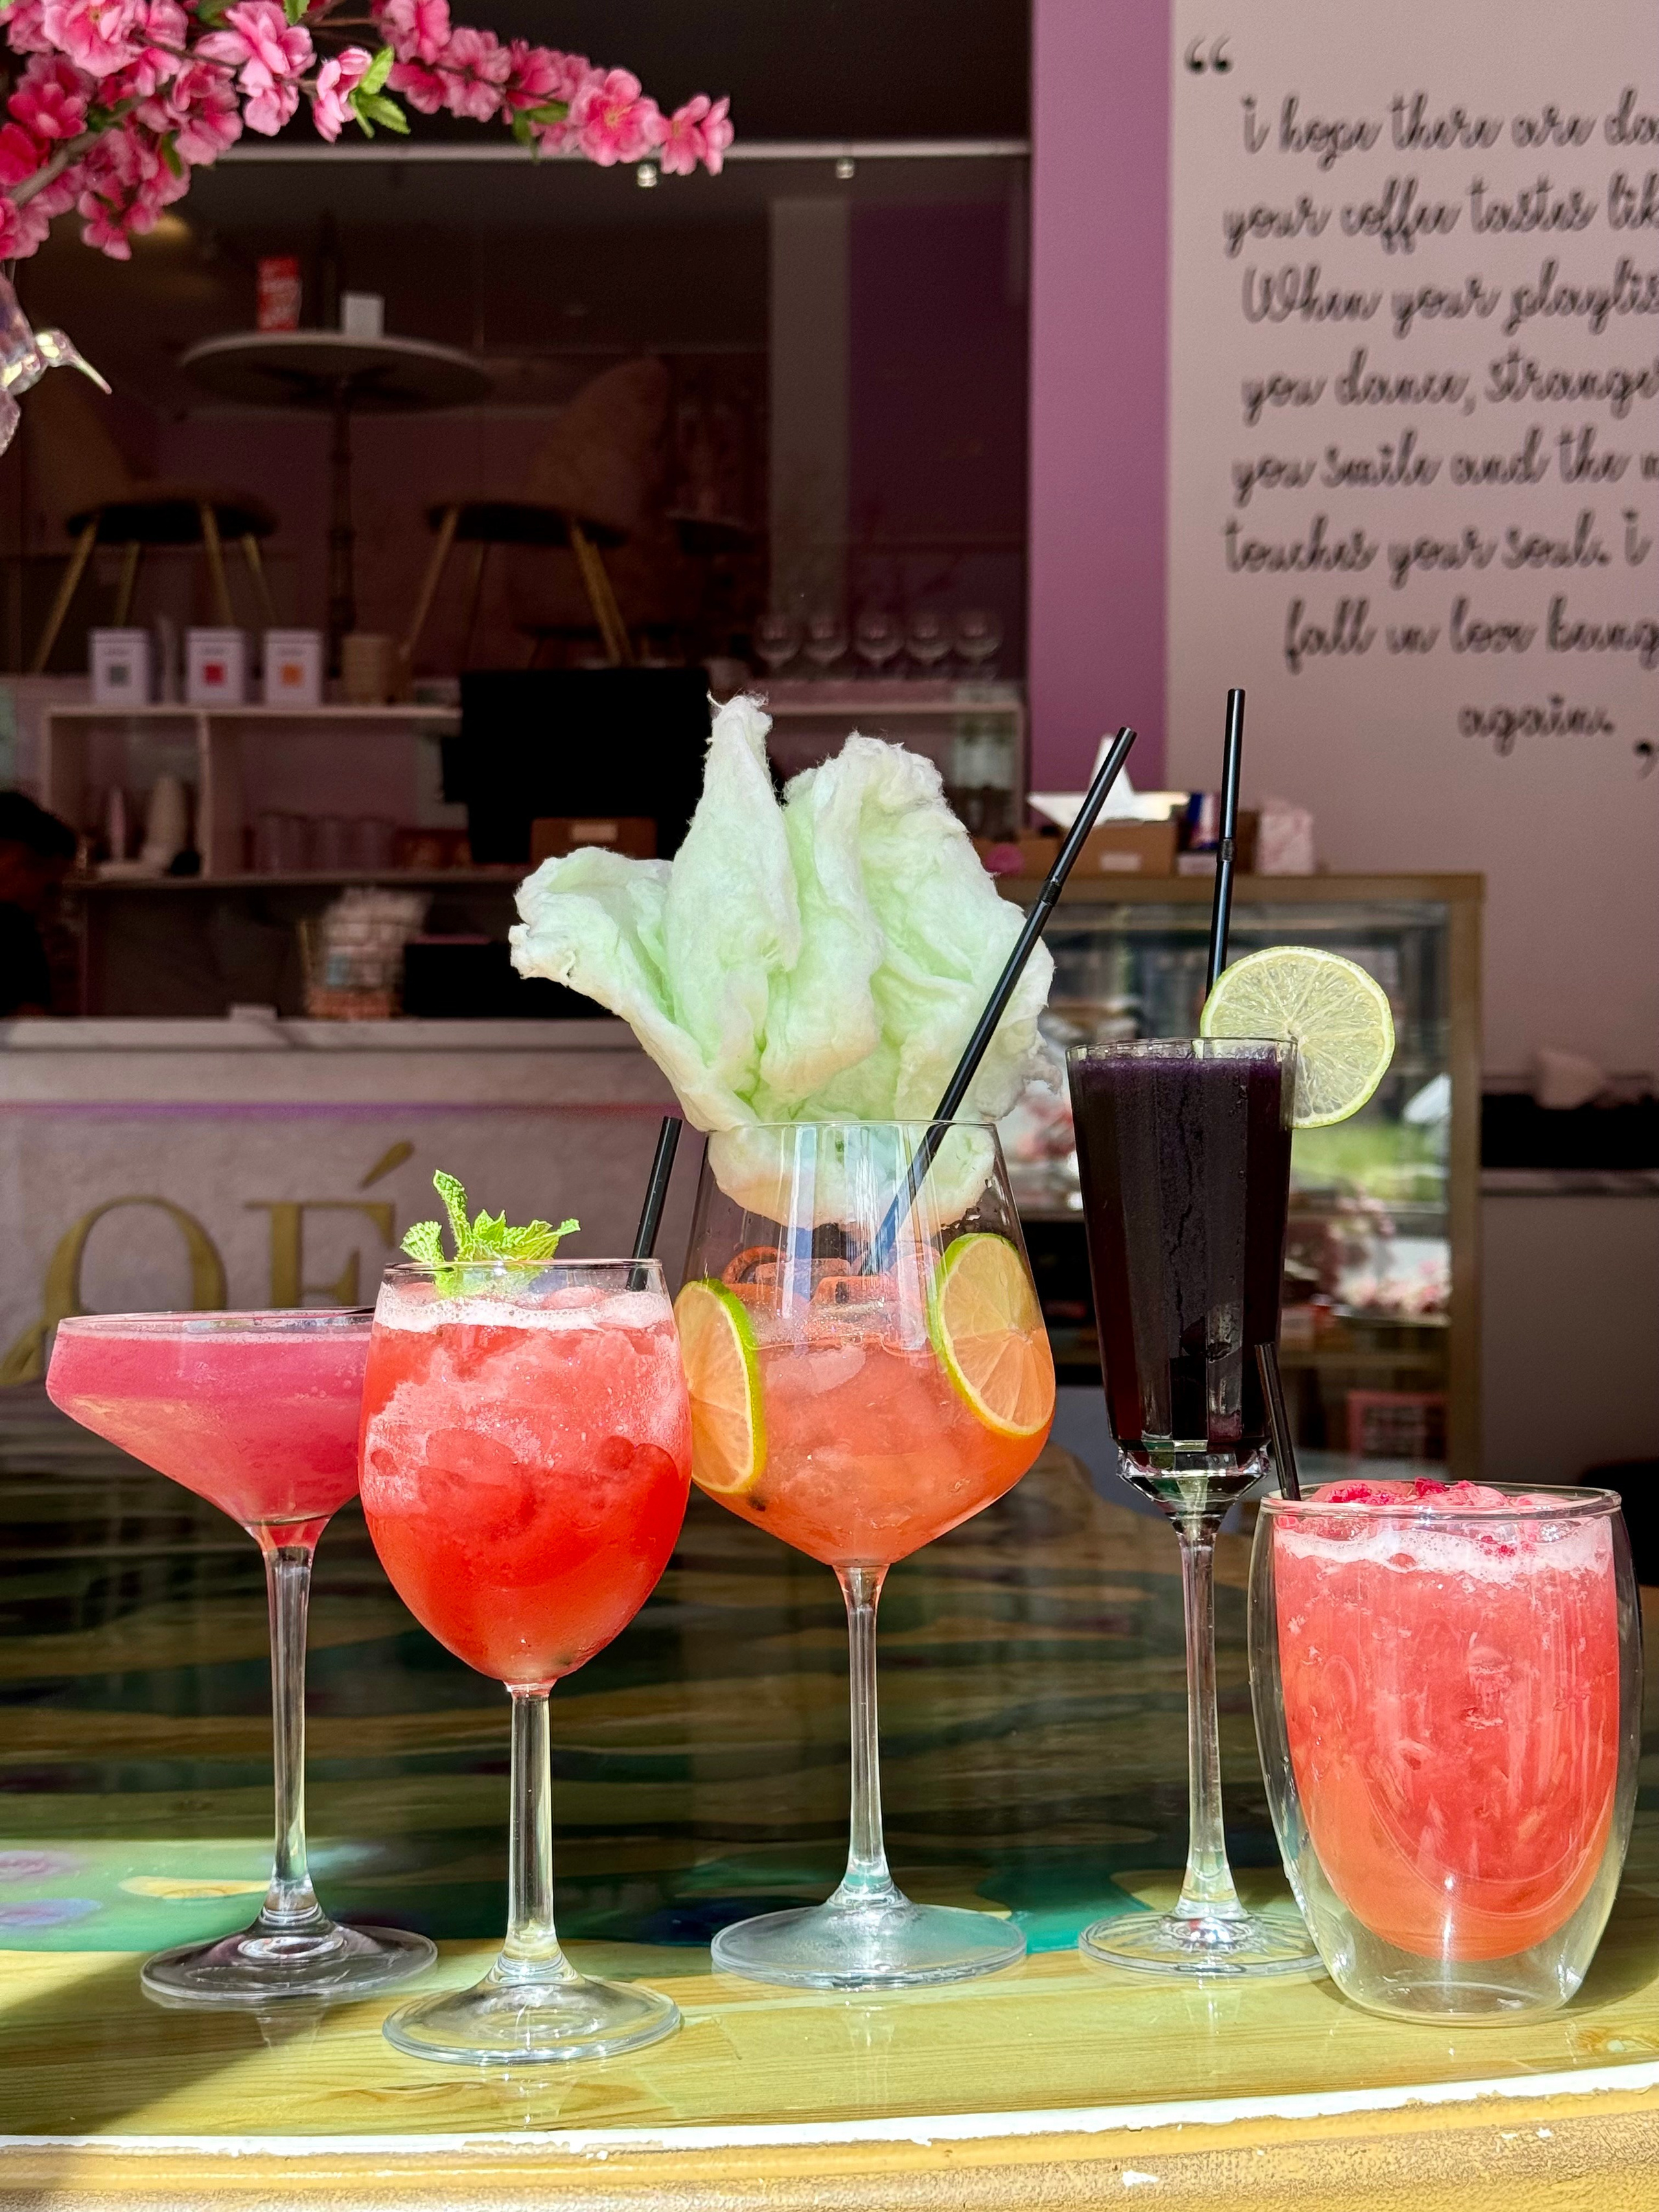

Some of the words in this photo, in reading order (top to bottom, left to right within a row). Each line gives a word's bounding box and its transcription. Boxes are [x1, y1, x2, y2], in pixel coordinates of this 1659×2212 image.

[1279, 93, 1383, 172] hope
[1388, 91, 1504, 150] there
[1511, 104, 1596, 148] are
[1224, 193, 1332, 259] your
[1340, 175, 1462, 255] coffee
[1467, 176, 1598, 234] tastes
[1242, 262, 1382, 323] When
[1391, 275, 1502, 340] your
[1242, 373, 1327, 427] you
[1485, 347, 1659, 419] strange
[1233, 456, 1317, 507] you
[1450, 426, 1550, 485] and
[1557, 425, 1631, 483] the
[1222, 514, 1379, 572] touches
[1388, 528, 1498, 590] your
[1284, 598, 1376, 675] fall
[1459, 693, 1615, 756] again.
